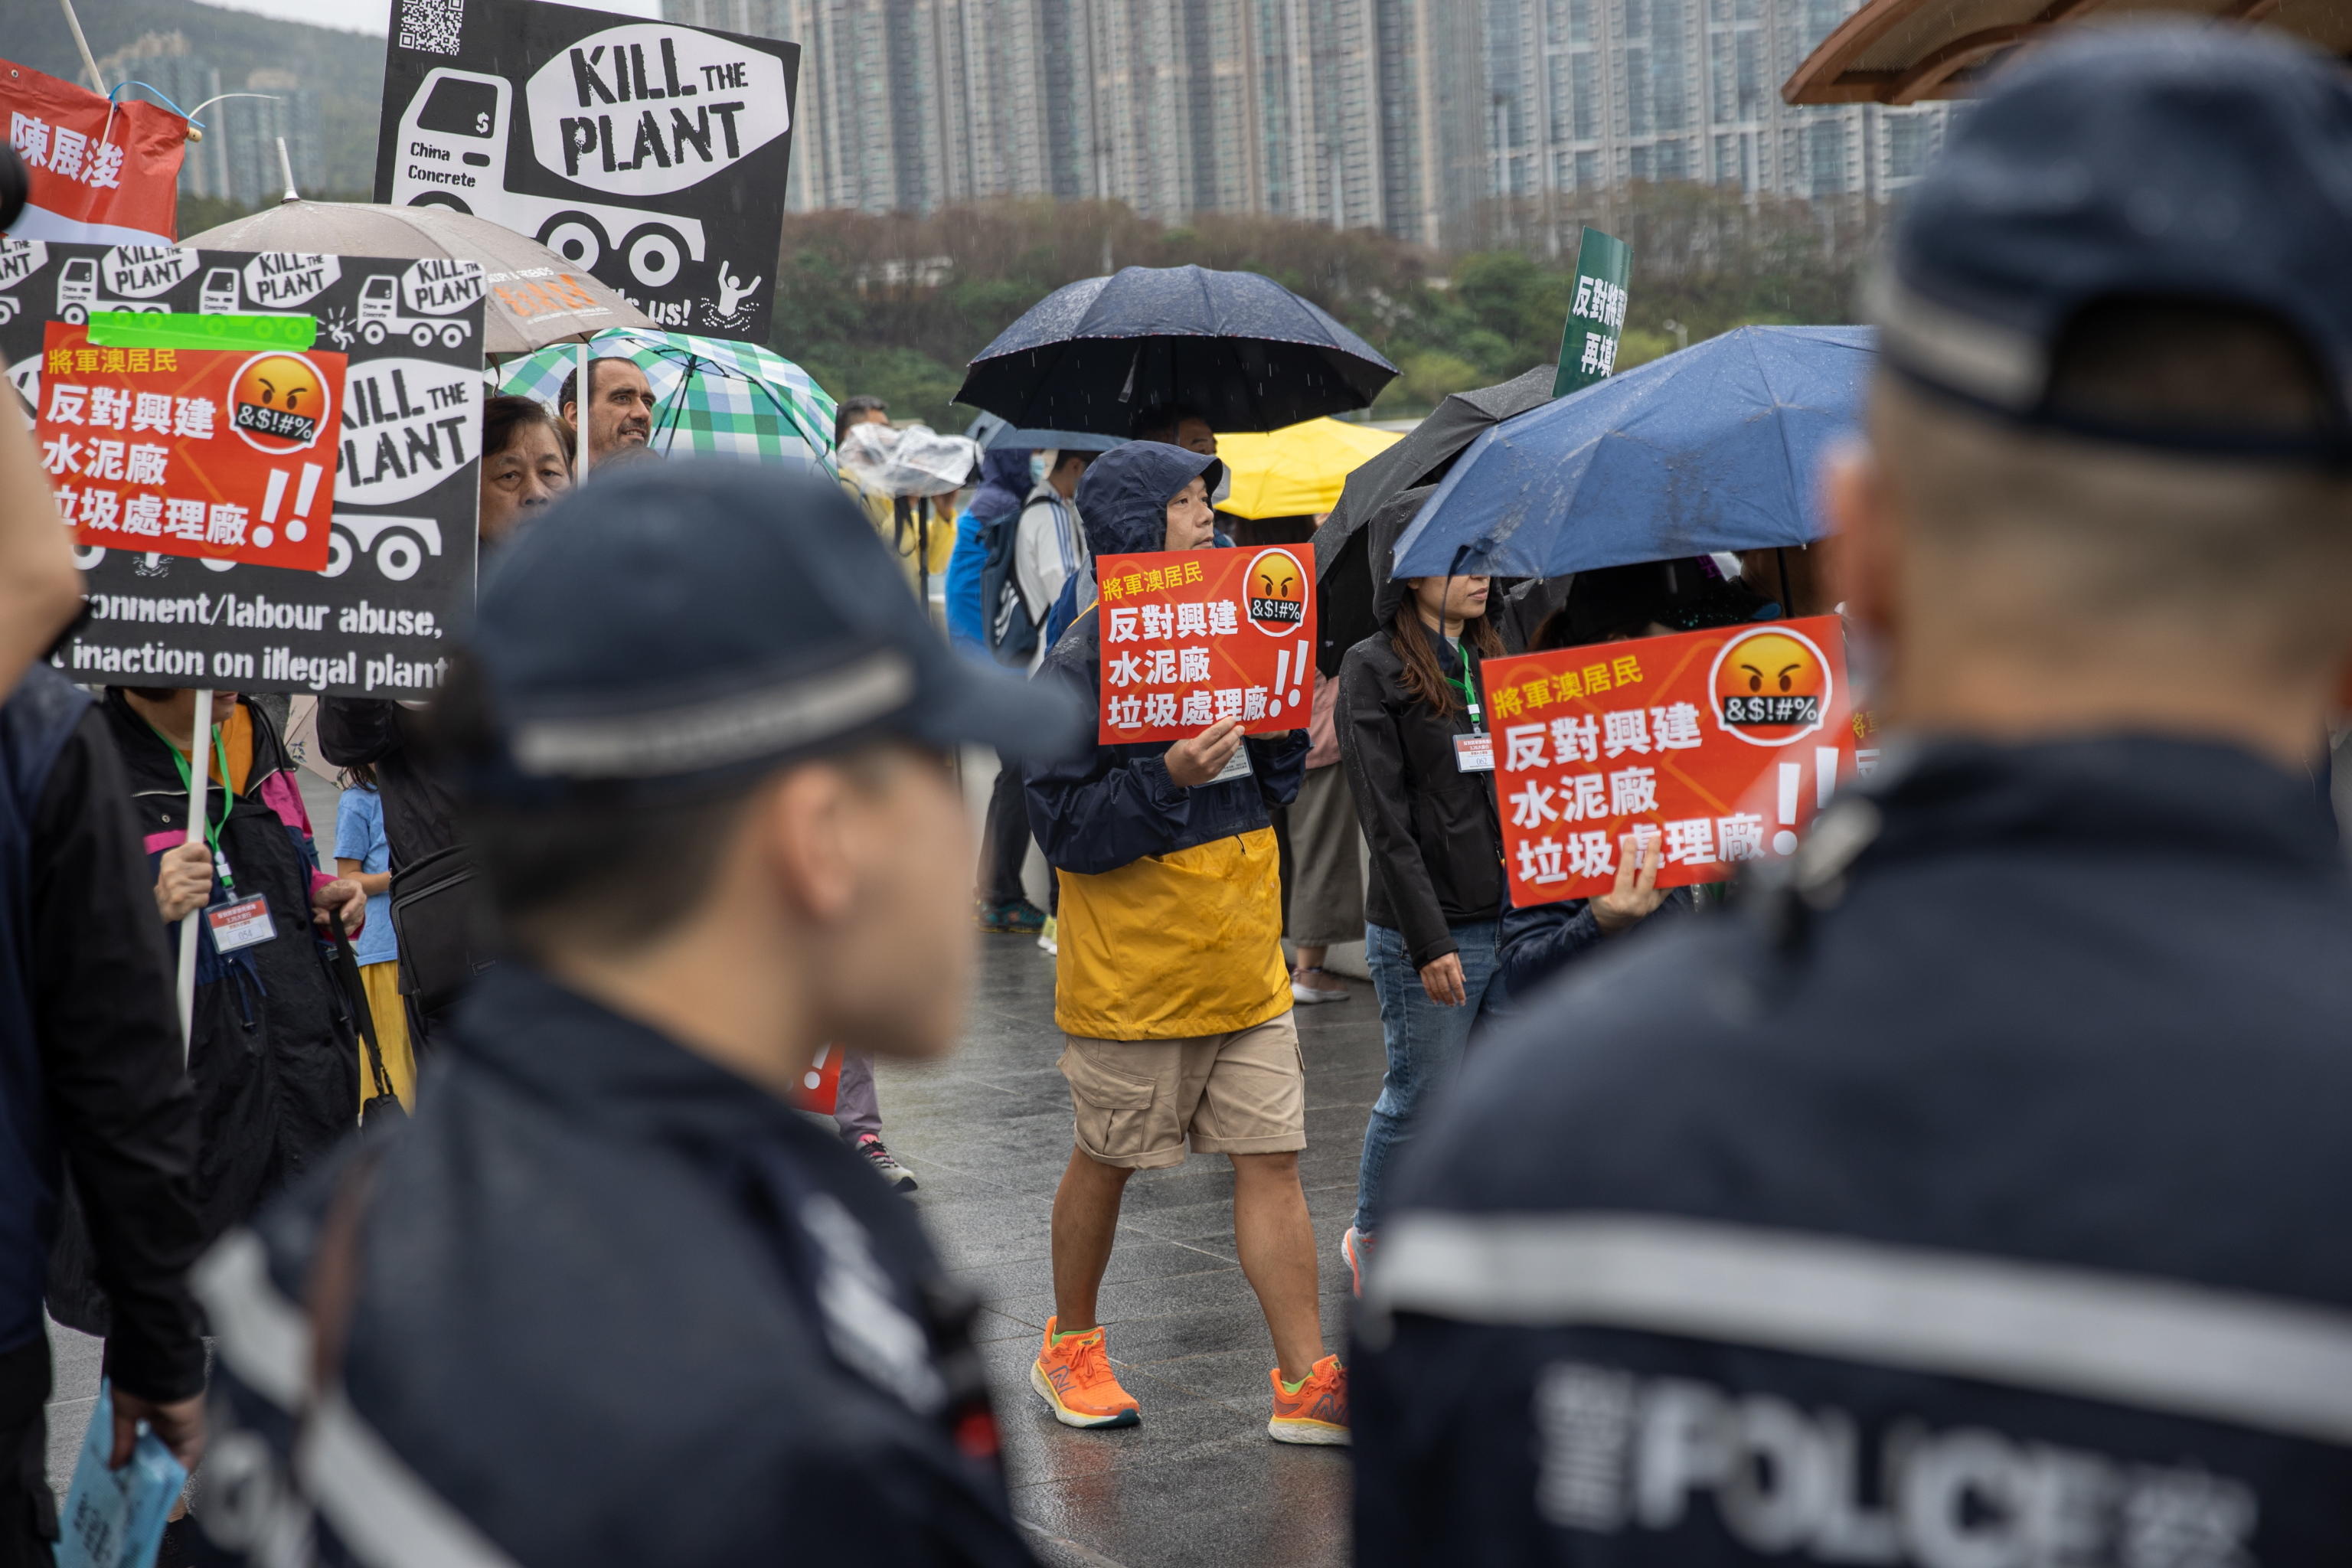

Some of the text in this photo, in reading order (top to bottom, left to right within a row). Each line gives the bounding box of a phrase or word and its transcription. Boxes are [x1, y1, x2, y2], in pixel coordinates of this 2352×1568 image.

[570, 38, 749, 108] KILL THE
[10, 111, 123, 189] 陳展浚
[410, 142, 451, 162] China
[560, 101, 746, 177] PLANT
[407, 165, 476, 188] Concrete
[115, 259, 183, 293] PLANT
[116, 245, 165, 268] KILL
[259, 253, 305, 278] KILL
[418, 260, 464, 284] KILL
[257, 269, 325, 304] PLANT
[416, 276, 482, 310] PLANT
[648, 299, 691, 326] us!
[47, 348, 178, 375] 將軍澳居民
[1581, 332, 1618, 377] 再填
[45, 383, 217, 439] 反對興建
[426, 382, 469, 410] THE
[40, 433, 169, 486] 水泥廠
[1102, 560, 1204, 601] 將軍澳居民
[339, 601, 443, 639] abuse,
[1108, 599, 1239, 643] 反對興建
[73, 637, 204, 677] inaction
[213, 652, 254, 680] on
[263, 646, 356, 691] illegal
[365, 654, 452, 691] plant
[1108, 646, 1211, 688] 水泥廠
[1107, 685, 1269, 729] 垃圾處理廠
[1491, 655, 1644, 719] 將軍澳居民
[1505, 702, 1703, 773] 反對興建
[1510, 766, 1659, 830] 水泥廠
